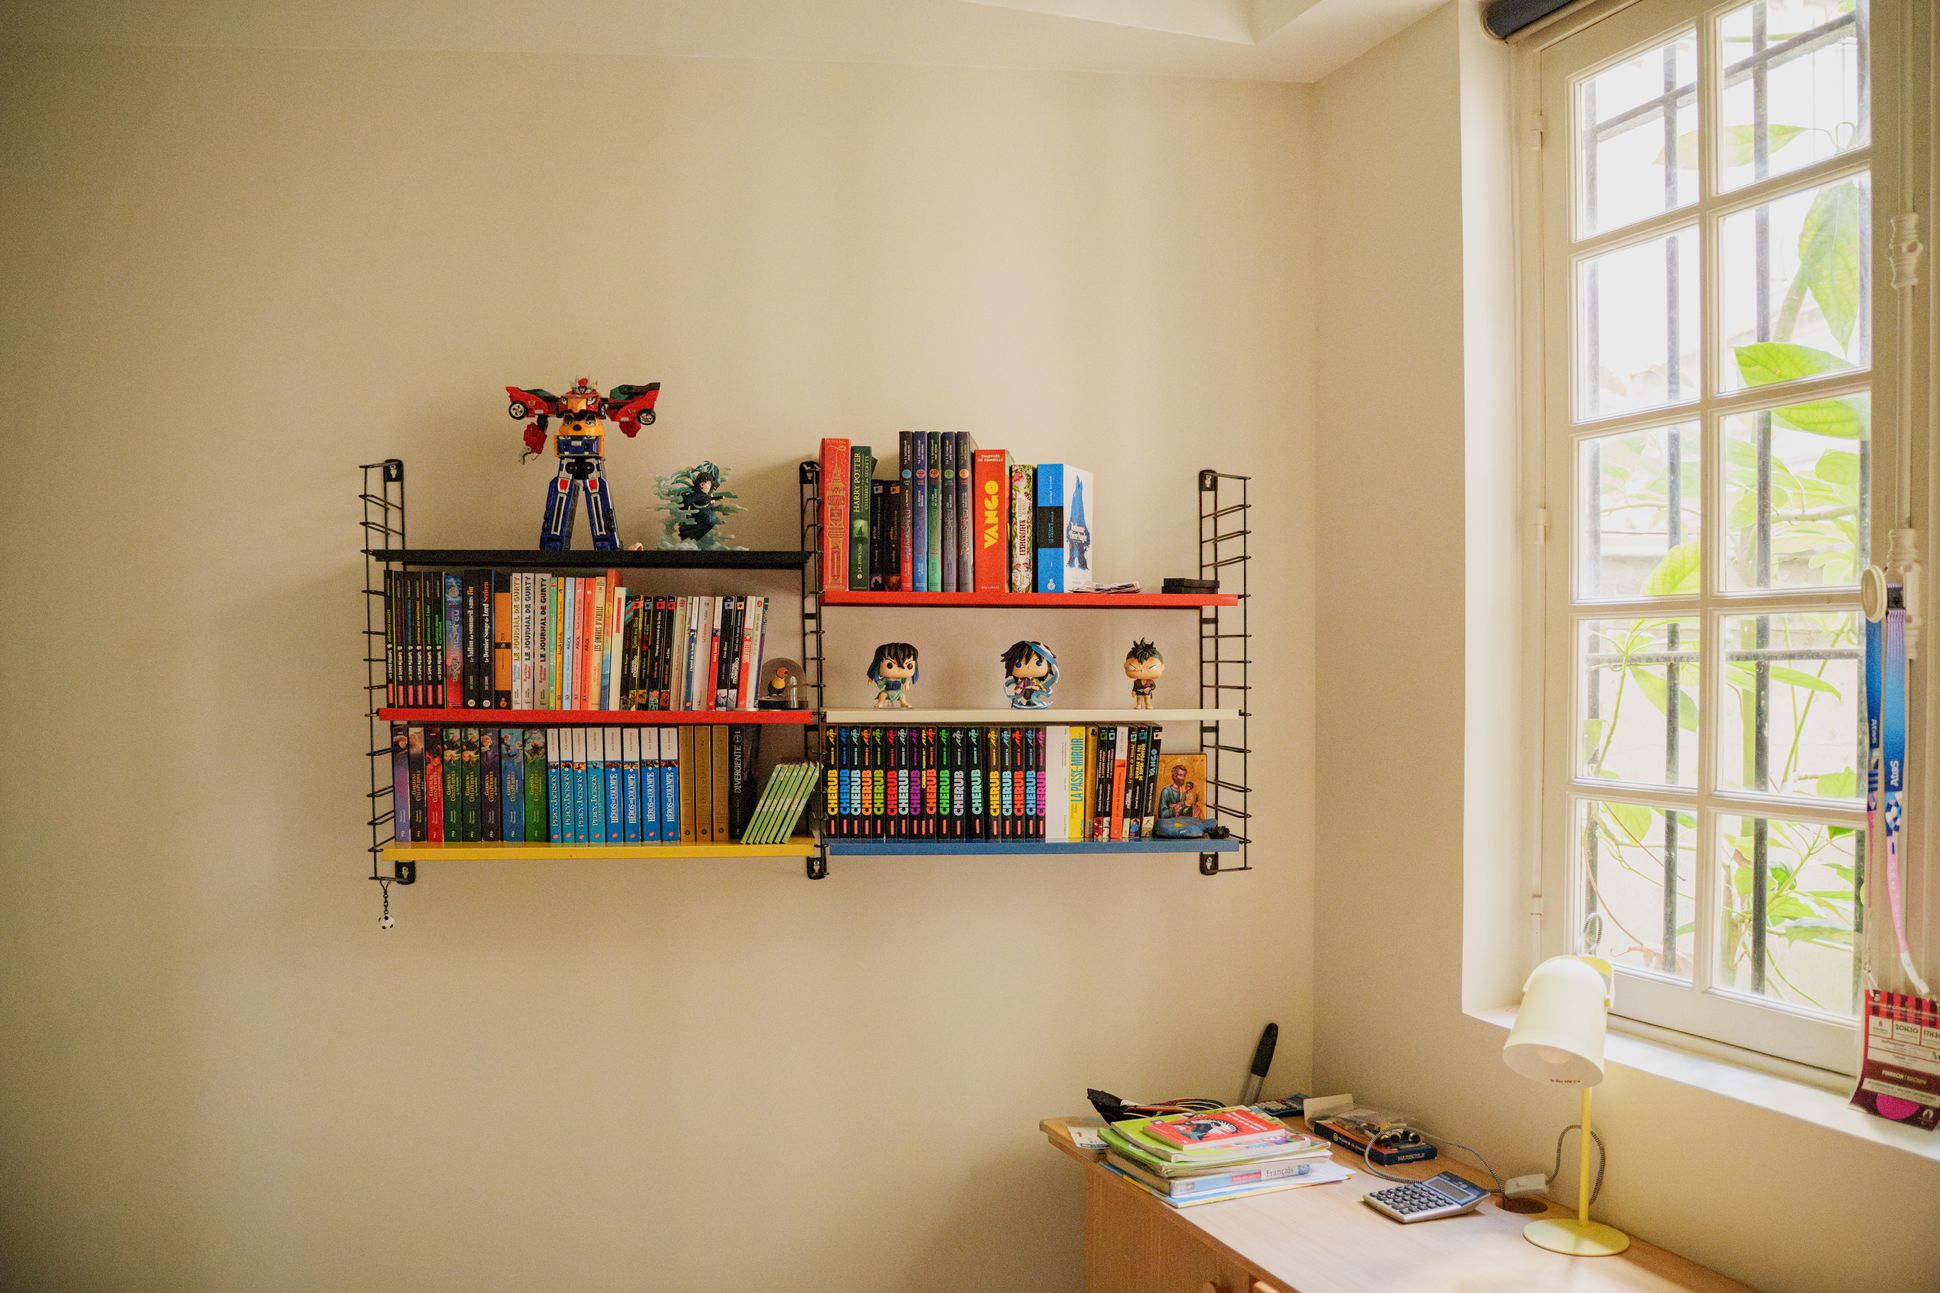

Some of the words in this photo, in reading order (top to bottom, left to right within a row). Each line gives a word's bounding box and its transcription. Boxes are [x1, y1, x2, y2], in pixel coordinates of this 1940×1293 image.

[984, 480, 998, 549] VANGO
[513, 605, 520, 614] DE
[524, 604, 531, 613] DE
[540, 605, 547, 615] DE
[595, 606, 603, 625] D'ACHILLE
[513, 652, 520, 661] LE
[524, 652, 531, 661] LE
[540, 653, 546, 662] LE
[594, 627, 602, 643] OMBRES
[734, 745, 742, 793] DIVERGENTE
[1148, 749, 1157, 777] VANGO
[550, 775, 558, 805] JACKSON
[647, 802, 655, 822] HÉROS
[667, 802, 675, 822] HÉROS
[827, 769, 838, 815] CHERUB
[840, 769, 850, 814] CHERUB
[851, 770, 861, 815] CHERUB
[862, 770, 872, 815] CHERUB
[873, 769, 884, 815] CHERUB
[887, 771, 897, 816] CHERUB
[898, 769, 909, 815] CHERUB
[910, 770, 920, 815] CHERUB
[926, 769, 936, 814] CHERUB
[940, 770, 950, 815] CHERUB
[954, 771, 964, 816] CHERUB
[971, 769, 982, 814] CHERUB
[990, 771, 1000, 816] CHERUB
[1002, 771, 1012, 816] CHERUB
[1013, 771, 1024, 816] CHERUB
[1026, 770, 1036, 815] CHERUB
[1037, 771, 1046, 816] CHERUB
[1071, 794, 1082, 802] LA
[610, 804, 618, 823] HÉROS
[628, 804, 636, 823] HÉROS
[1265, 1166, 1295, 1178] Français
